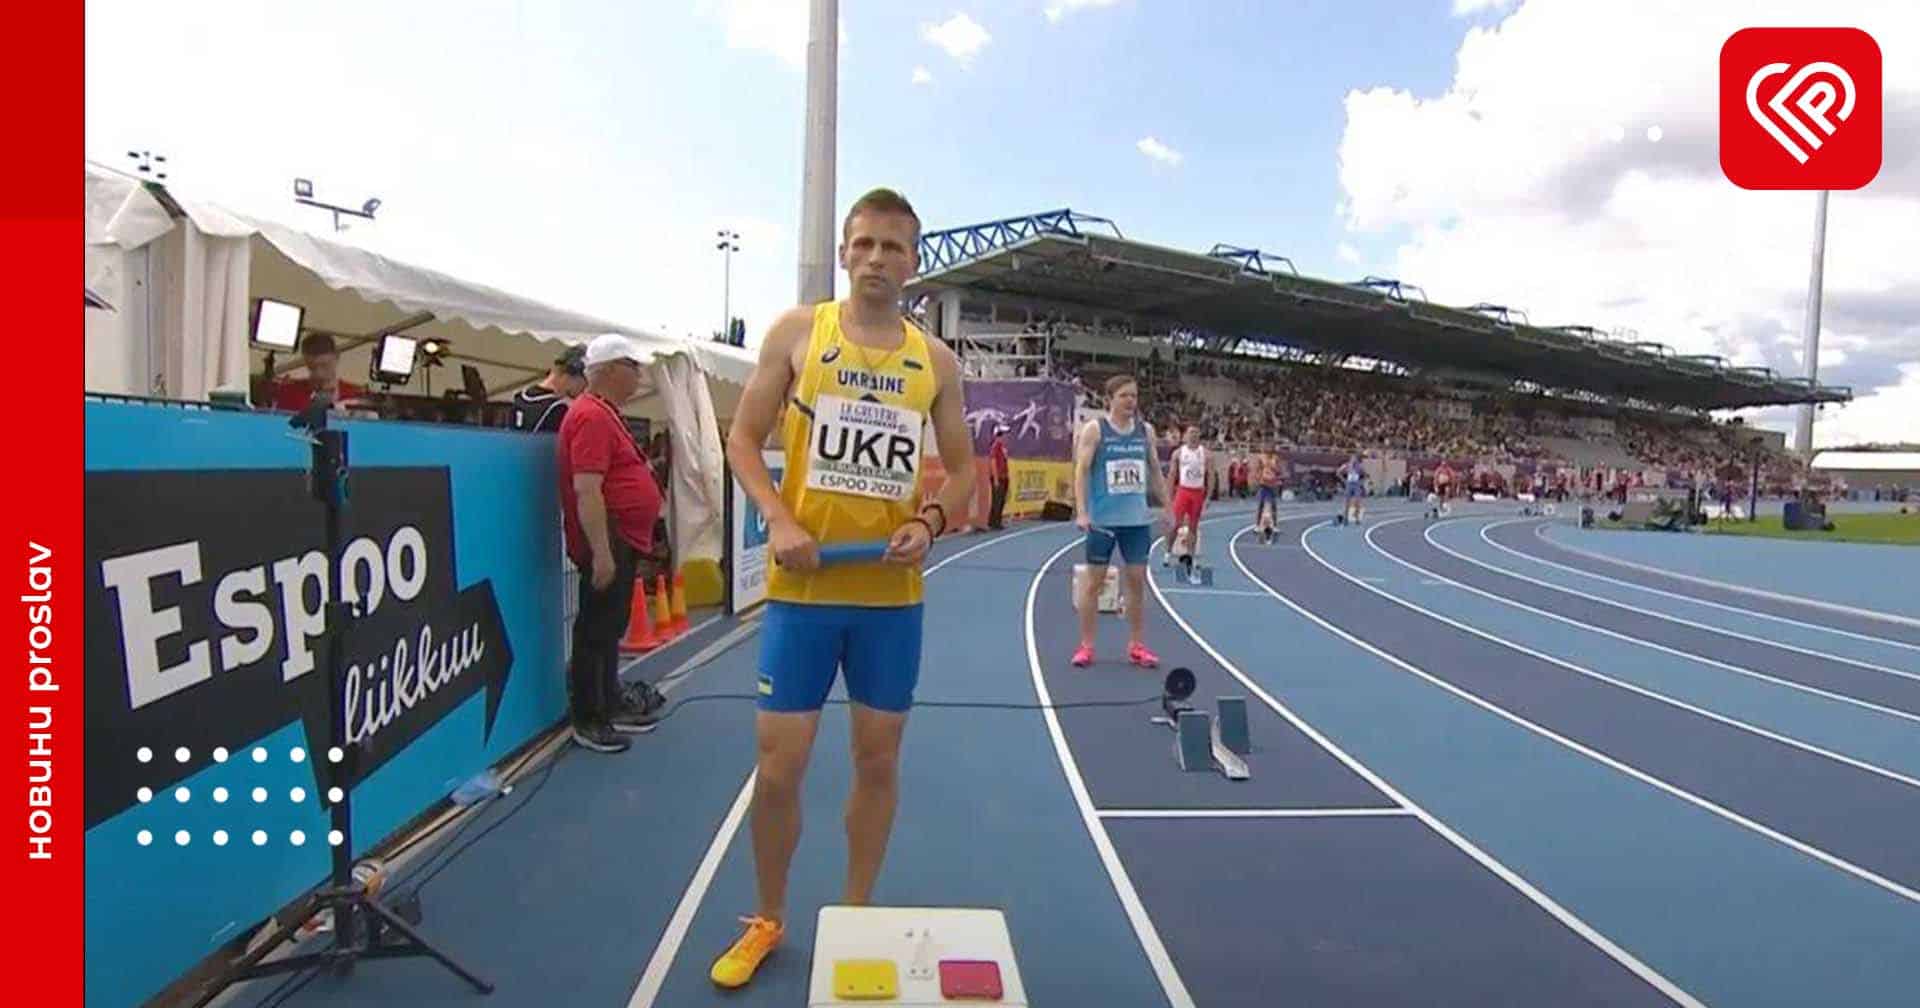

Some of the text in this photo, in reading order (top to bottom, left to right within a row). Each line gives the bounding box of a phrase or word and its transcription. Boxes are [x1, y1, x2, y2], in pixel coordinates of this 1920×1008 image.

[837, 369, 906, 394] UKRAINE
[818, 423, 915, 472] UKR
[820, 475, 902, 497] ESPOO 2023
[1112, 469, 1141, 487] FIN
[101, 525, 428, 711] Espoo
[344, 622, 486, 746] liikkuu
